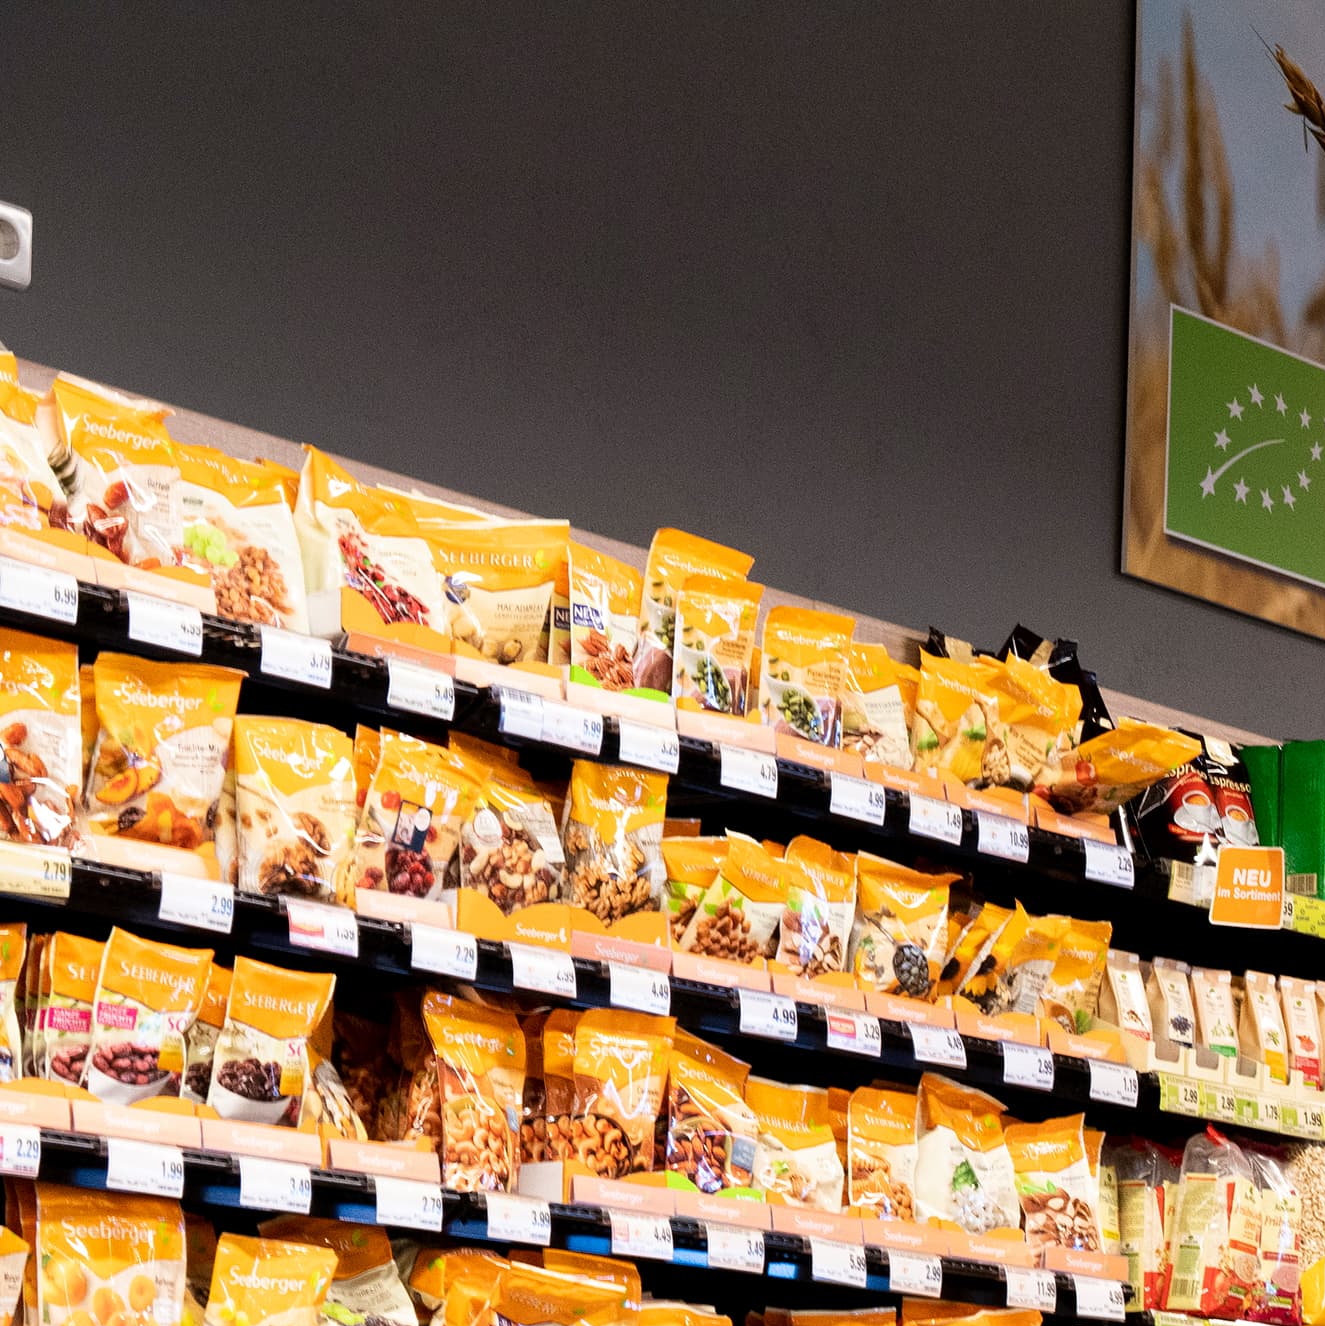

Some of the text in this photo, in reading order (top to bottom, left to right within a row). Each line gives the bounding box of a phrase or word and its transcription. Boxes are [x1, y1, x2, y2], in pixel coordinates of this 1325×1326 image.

[440, 548, 533, 569] SEEBERGER
[1232, 867, 1272, 886] NEU
[1217, 887, 1281, 902] im Sortiment
